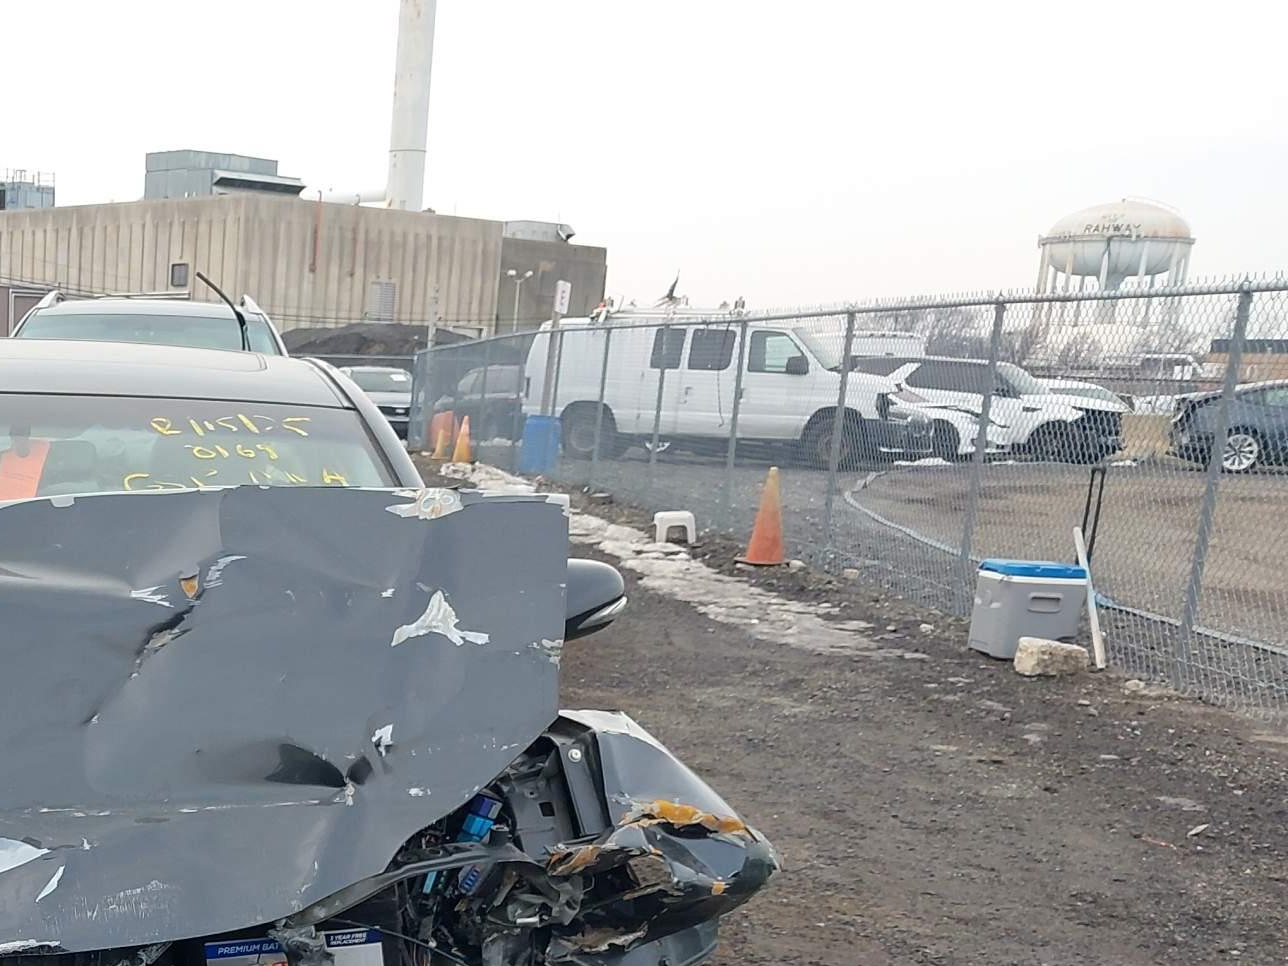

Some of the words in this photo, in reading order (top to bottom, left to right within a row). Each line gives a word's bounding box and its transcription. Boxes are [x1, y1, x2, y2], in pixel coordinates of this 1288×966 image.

[1084, 223, 1142, 233] RAHWAY
[329, 937, 367, 946] REPLACEMENT
[217, 943, 261, 955] PREMIUM
